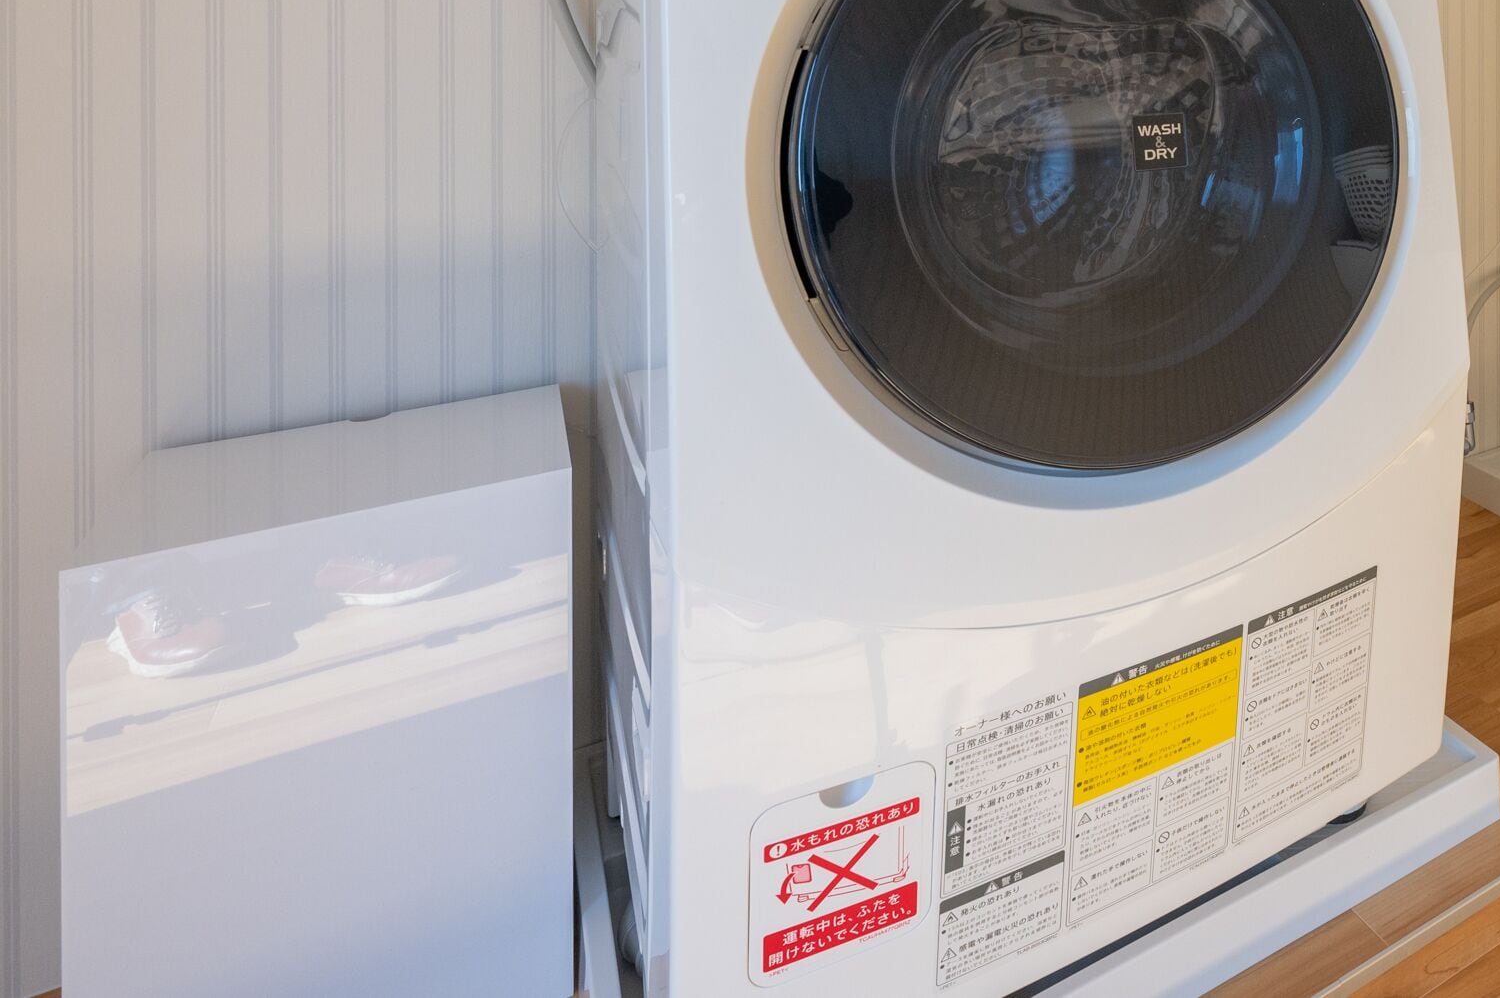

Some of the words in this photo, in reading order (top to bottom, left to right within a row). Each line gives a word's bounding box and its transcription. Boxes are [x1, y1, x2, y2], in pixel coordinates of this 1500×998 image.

[1137, 123, 1181, 137] WASH
[1155, 136, 1166, 148] &
[1144, 147, 1178, 160] DRY
[1278, 607, 1294, 620] 注意
[1102, 647, 1237, 706] 油の付いた衣類などは(洗濯後でも)
[1128, 665, 1148, 680] 警告
[955, 692, 1066, 737] オーナー様へのお願い
[1100, 685, 1172, 718] 絶対に乾燥しない
[956, 708, 1064, 752] 日常点検・清掃のお願い
[956, 761, 1060, 806] 排水フィルターのお手入れ
[977, 778, 1051, 811] 水漏れの恐れあり
[791, 801, 914, 852] 水もれの恐れあり
[950, 836, 960, 857] 注意
[1001, 871, 1024, 886] 警告
[961, 886, 1020, 916] 発火の恐れあり
[783, 893, 900, 946] 運転中は、ふたを
[959, 902, 1059, 953] 感電や漏電火災の恐れあり
[768, 908, 912, 966] 開けないでください。
